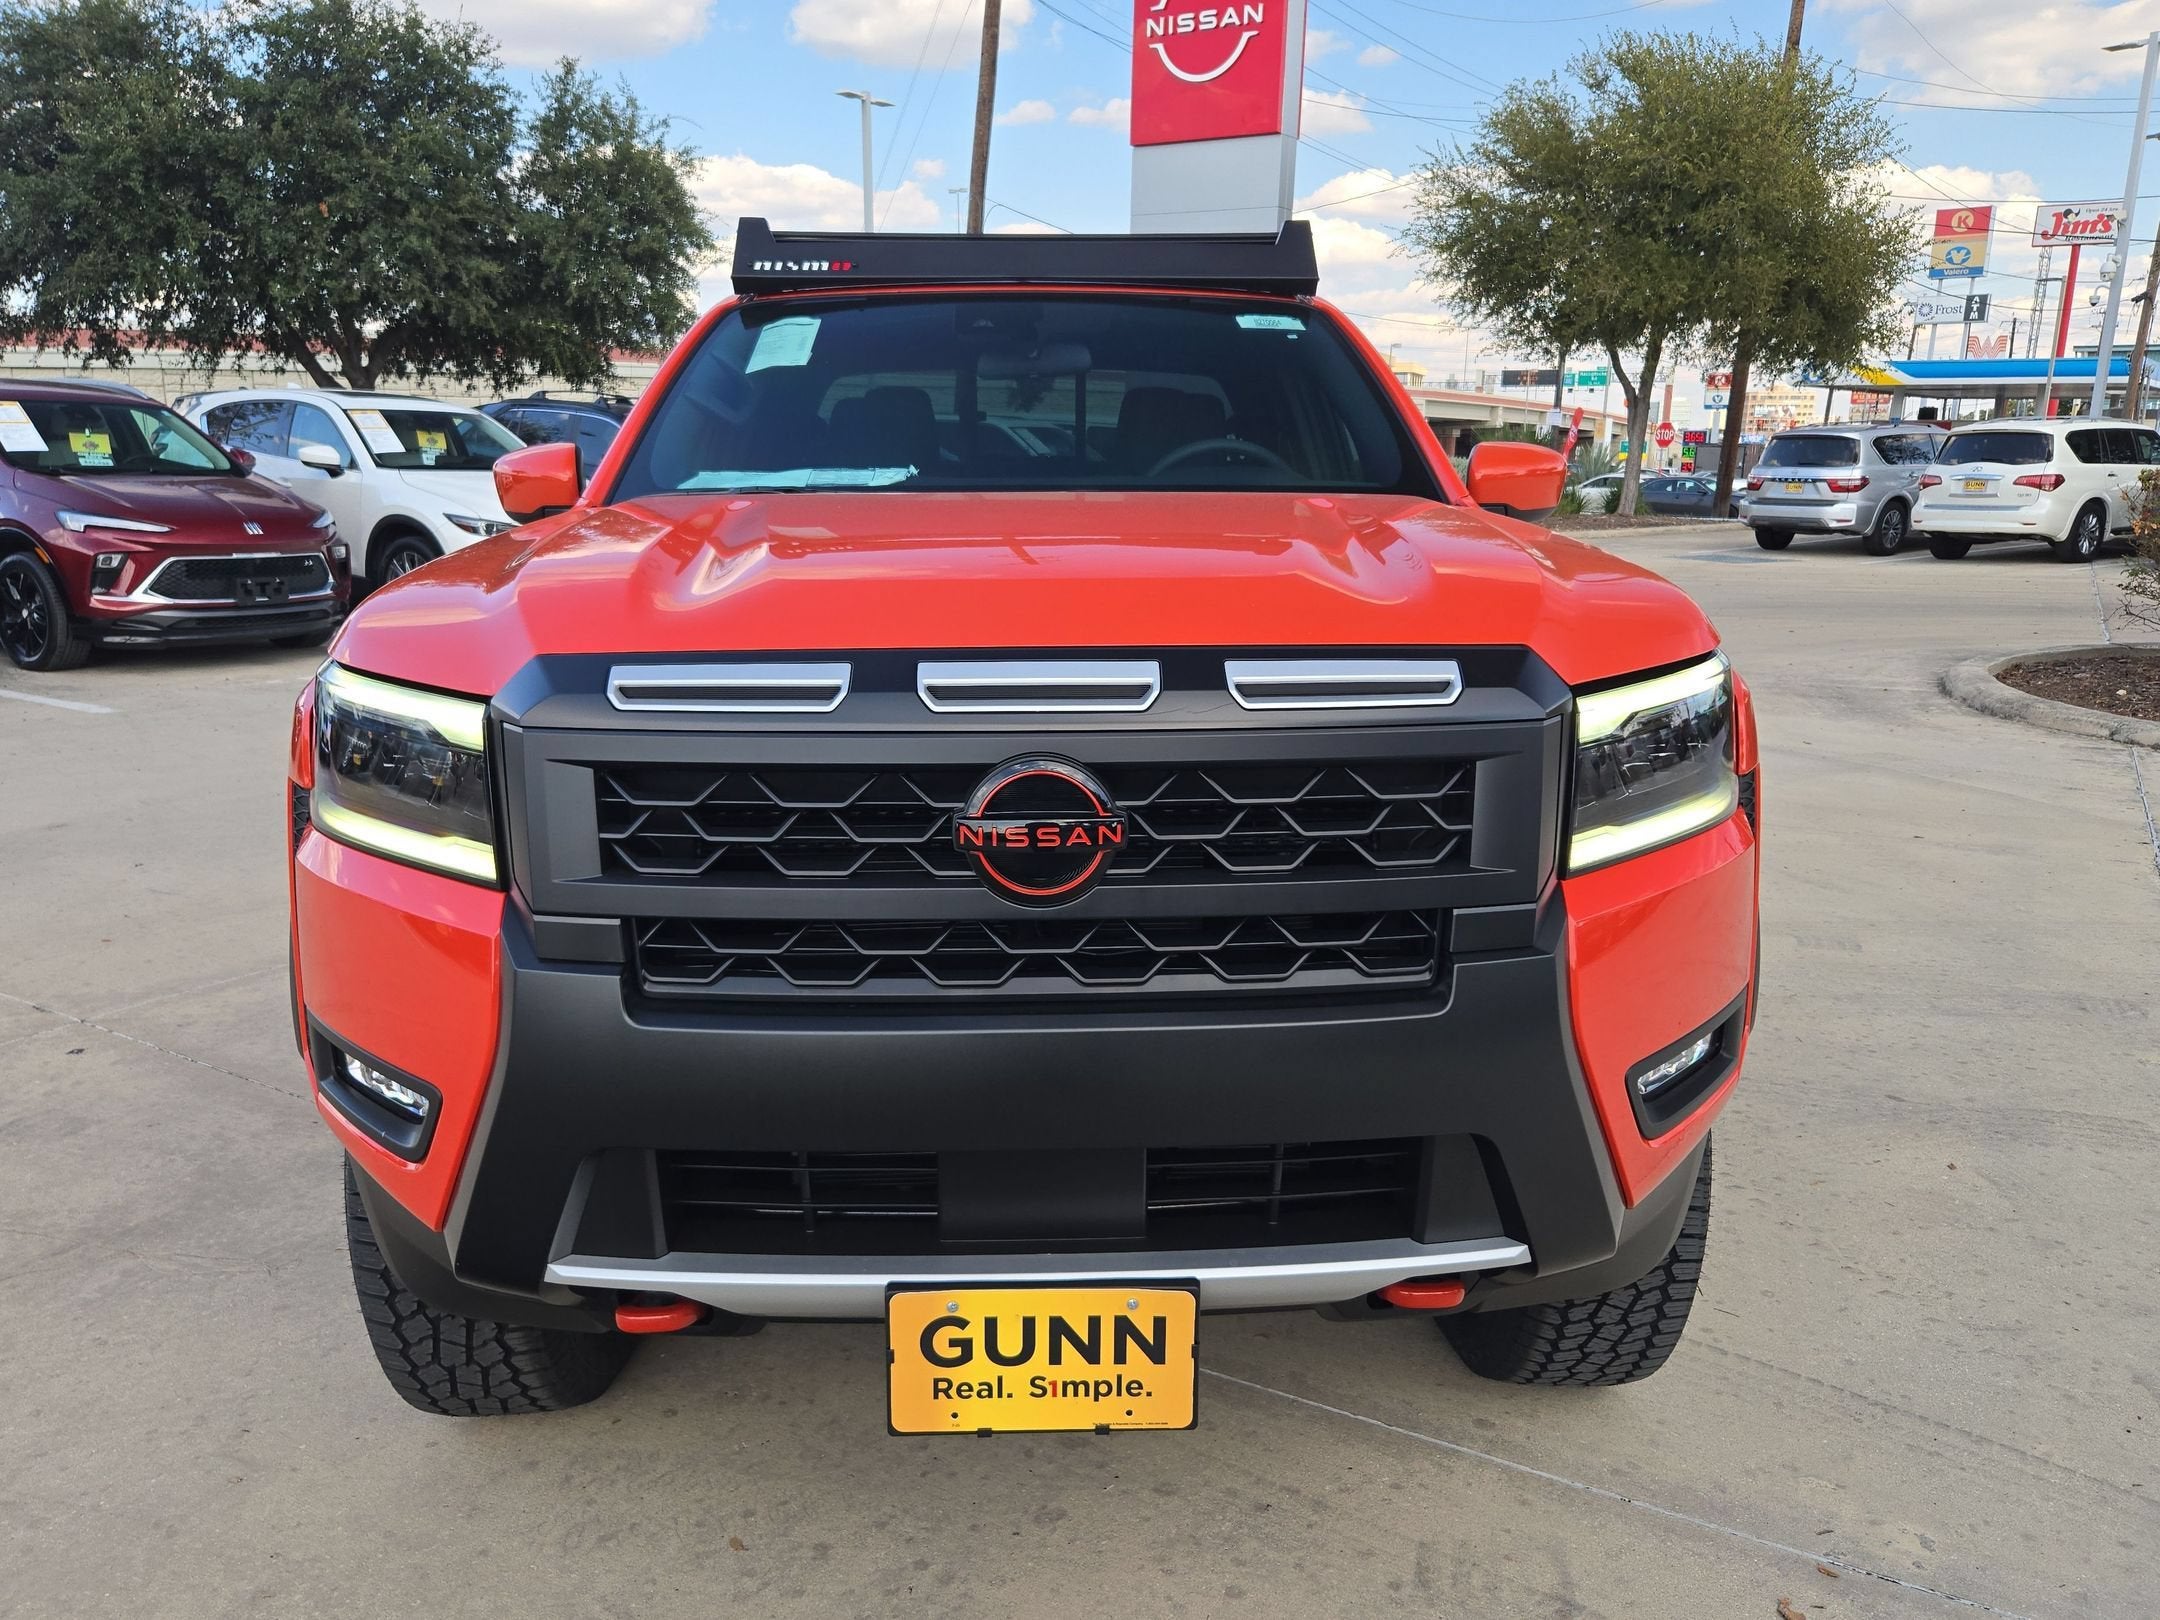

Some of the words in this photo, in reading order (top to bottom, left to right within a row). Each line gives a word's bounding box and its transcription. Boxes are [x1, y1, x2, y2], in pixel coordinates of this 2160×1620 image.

[1146, 3, 1264, 37] NISSAN
[1957, 214, 1971, 228] K
[2041, 211, 2112, 240] Jim's
[1943, 267, 1969, 276] Valero
[1935, 304, 1964, 315] Frost
[1969, 296, 1981, 320] ATM
[1656, 429, 1674, 440] STOP
[1965, 481, 1986, 489] GUNN
[959, 825, 1123, 848] NISSAN
[919, 1315, 1167, 1368] GUNN
[932, 1375, 1014, 1400] Real.
[1029, 1374, 1153, 1402] S1mple.
